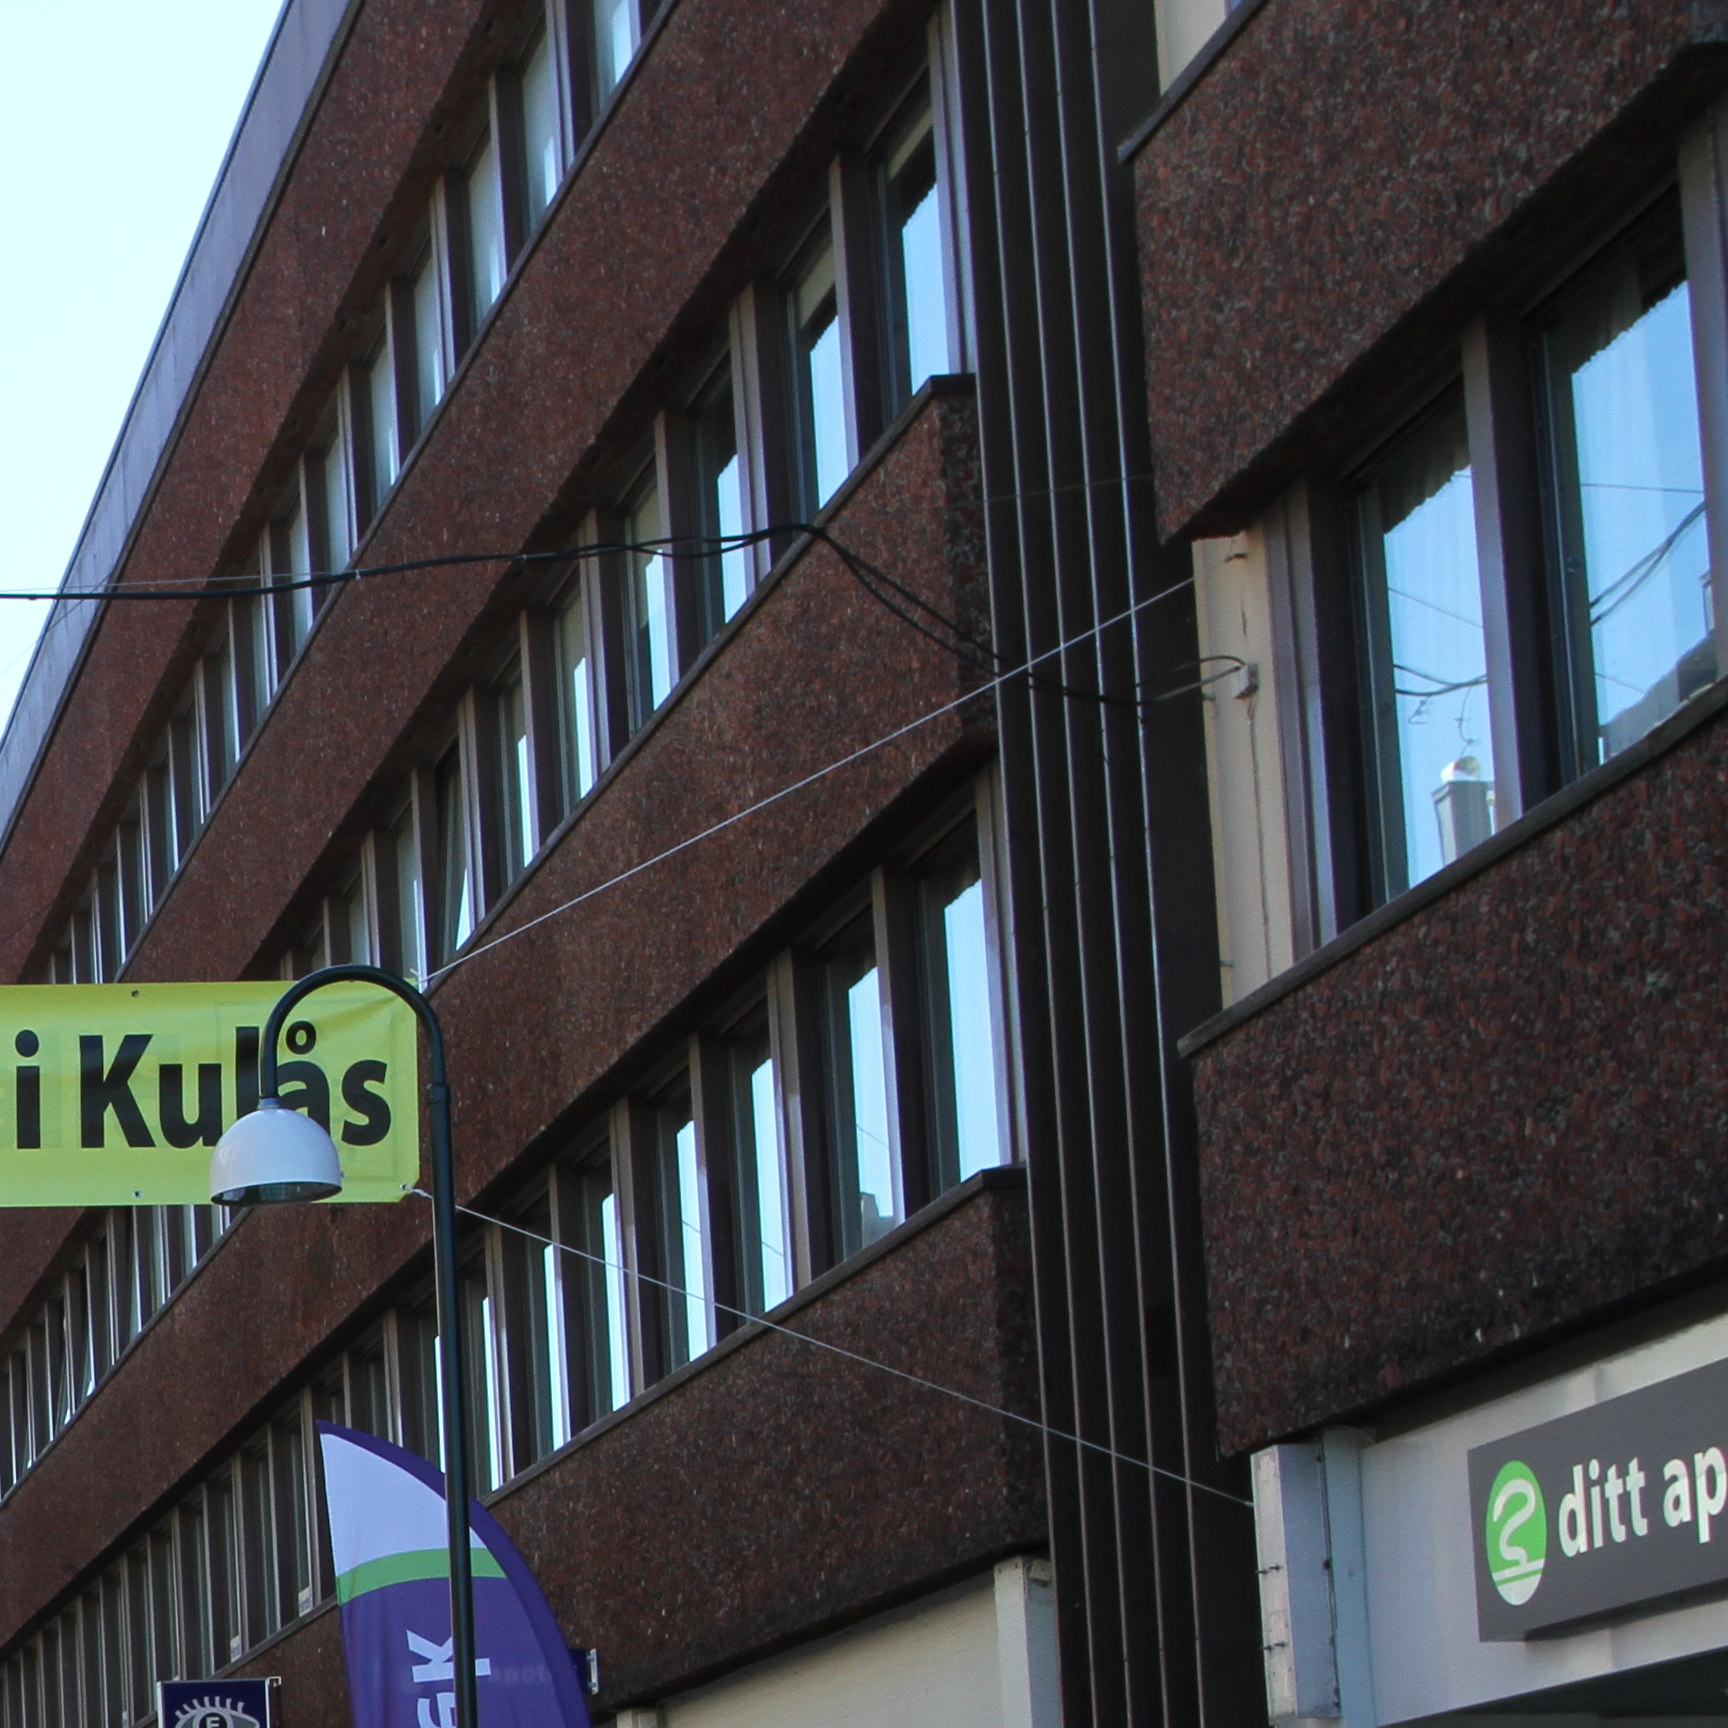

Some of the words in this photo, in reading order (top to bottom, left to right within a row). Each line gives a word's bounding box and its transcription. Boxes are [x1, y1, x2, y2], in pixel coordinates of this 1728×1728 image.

[15, 1029, 42, 1150] i
[79, 1020, 391, 1149] Kulås
[1559, 1457, 1648, 1557] ditt
[1662, 1447, 1728, 1544] ap
